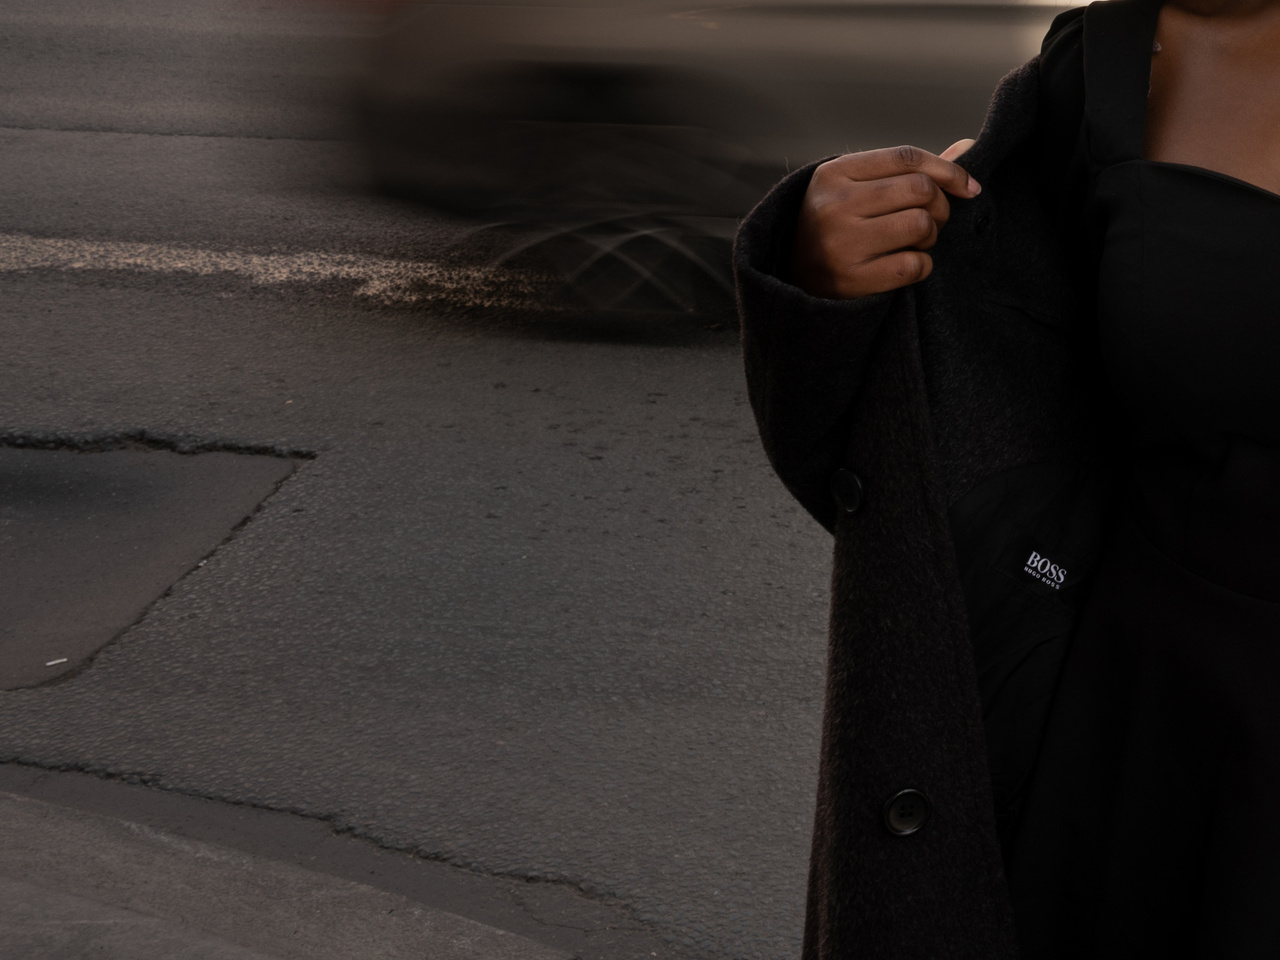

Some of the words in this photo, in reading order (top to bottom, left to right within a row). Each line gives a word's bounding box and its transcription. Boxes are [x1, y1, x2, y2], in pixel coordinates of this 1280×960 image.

[1024, 566, 1041, 579] HUGO
[1041, 576, 1060, 590] BOSS
[1026, 551, 1067, 583] BOSS
